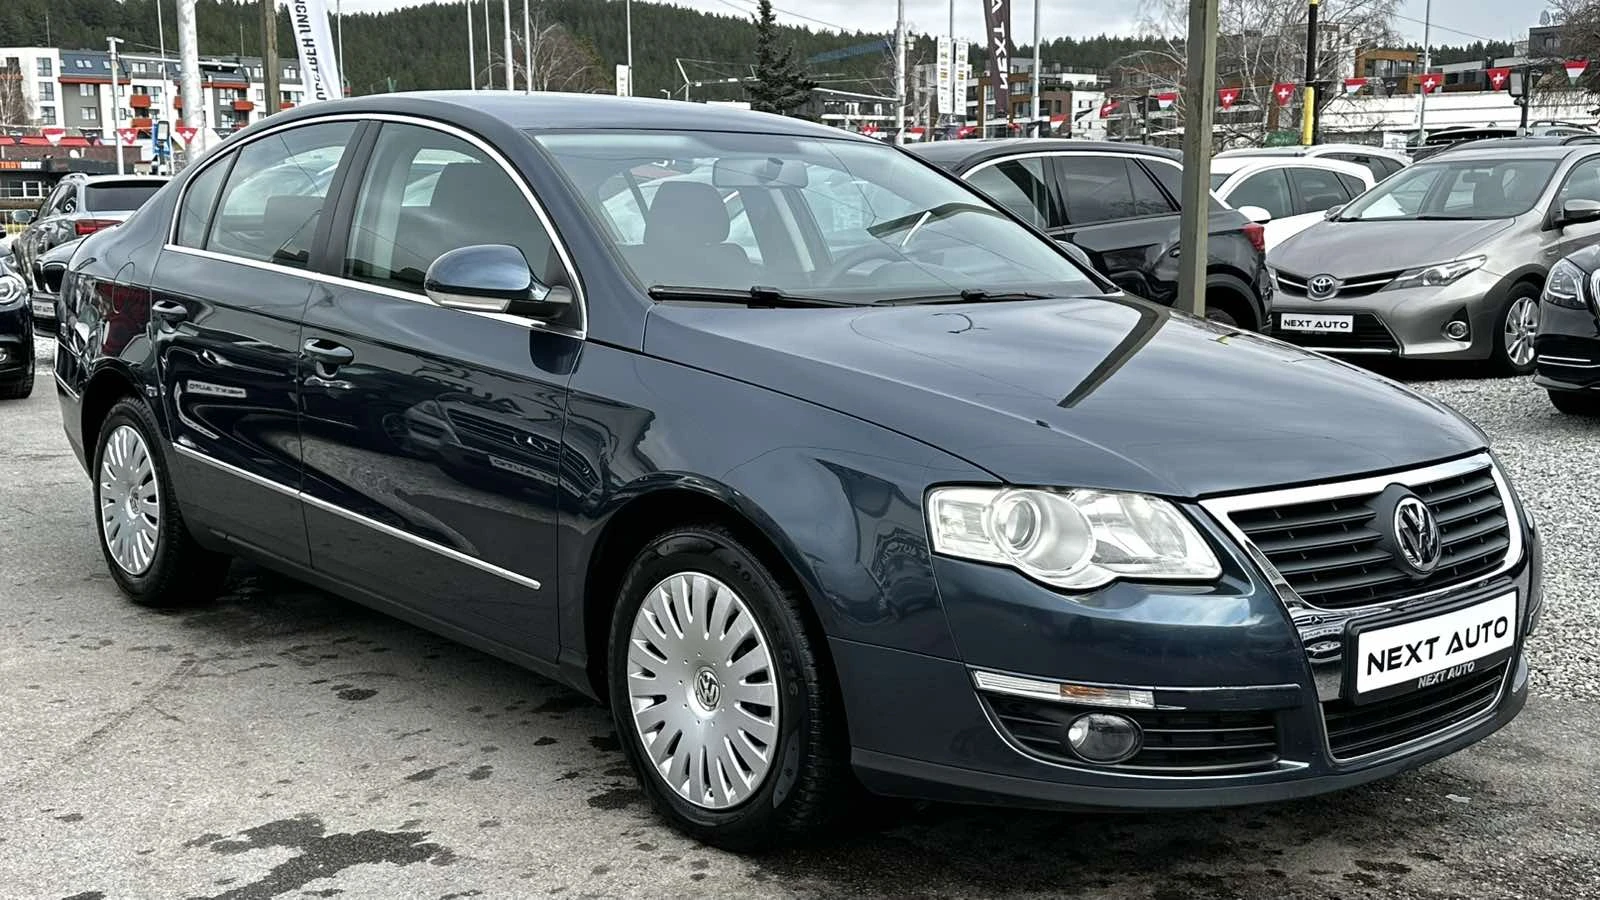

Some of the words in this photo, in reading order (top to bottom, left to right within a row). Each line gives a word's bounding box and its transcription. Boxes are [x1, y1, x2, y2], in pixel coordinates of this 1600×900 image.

[1284, 319, 1312, 328] NEXT
[1314, 321, 1349, 329] AUTO
[1366, 635, 1441, 676] NEXT
[1445, 616, 1508, 656] AUTO
[1417, 670, 1448, 688] NEXT
[1447, 661, 1476, 679] AUTO
